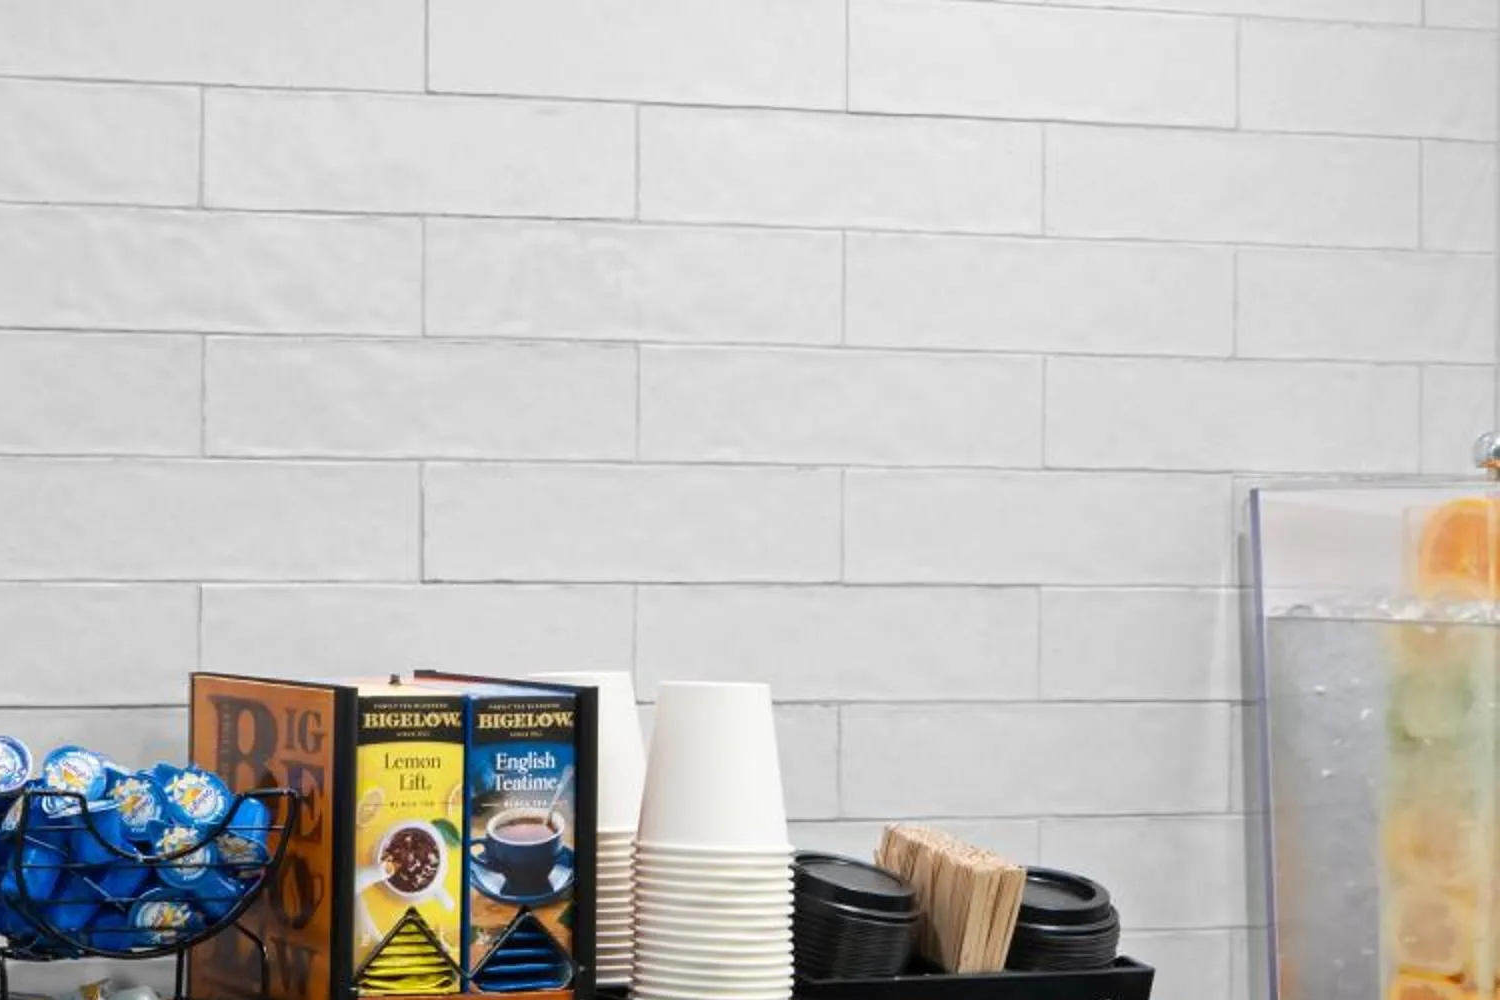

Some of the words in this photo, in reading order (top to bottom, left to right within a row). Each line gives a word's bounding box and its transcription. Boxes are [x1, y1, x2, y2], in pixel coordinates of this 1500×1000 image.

[362, 710, 462, 730] BIGELOW
[476, 710, 575, 730] BIGELOW
[384, 751, 442, 770] Lemon
[495, 752, 556, 775] English
[399, 775, 431, 791] Lift
[493, 774, 558, 792] Teatime
